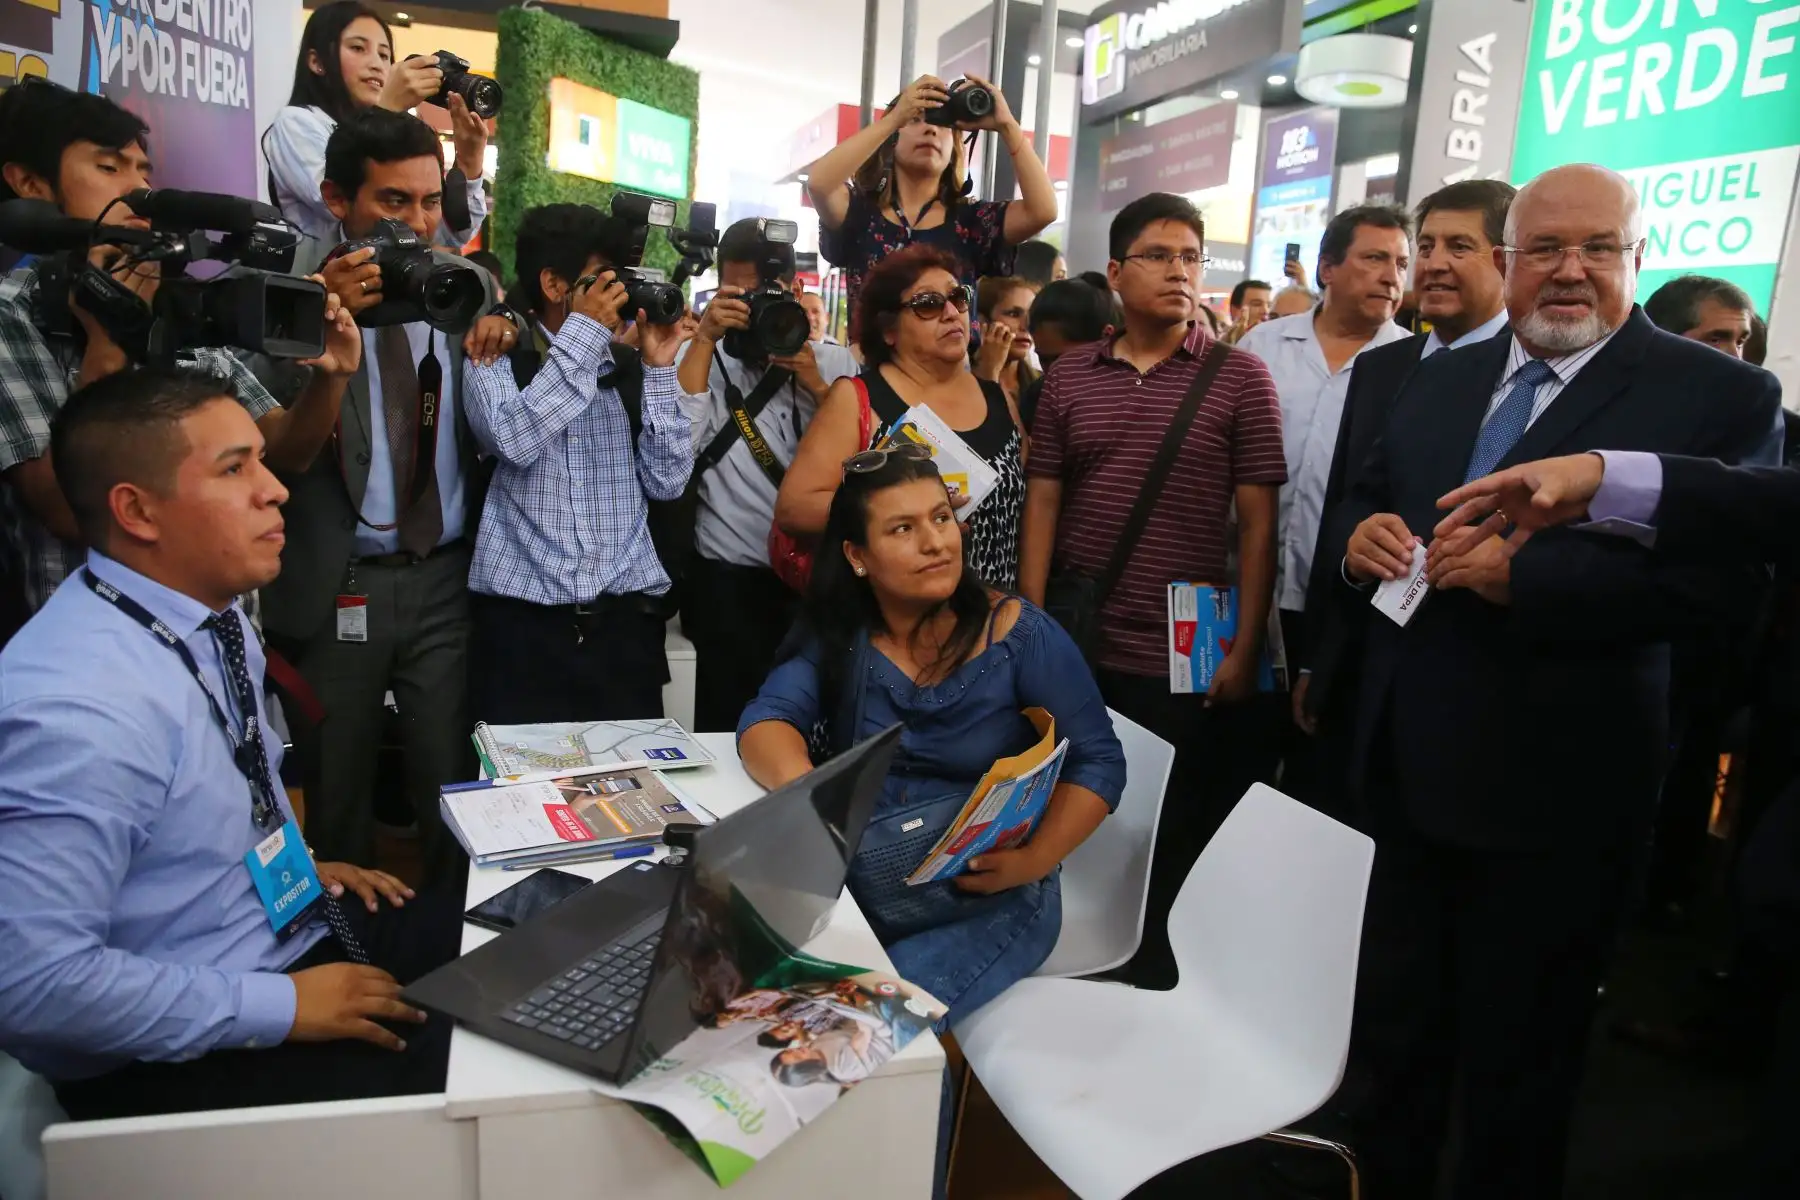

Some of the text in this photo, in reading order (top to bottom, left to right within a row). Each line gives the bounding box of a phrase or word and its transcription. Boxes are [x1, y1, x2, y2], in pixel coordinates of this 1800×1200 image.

[1545, 0, 1774, 60] BO
[91, 5, 250, 109] Y POR FUERA
[1539, 5, 1800, 135] VERDE
[1627, 162, 1761, 209] IGUEL
[422, 393, 435, 426] EOS
[735, 409, 755, 439] Nikon
[1399, 588, 1418, 611] DEPA
[274, 876, 312, 913] EXPOSITOR
